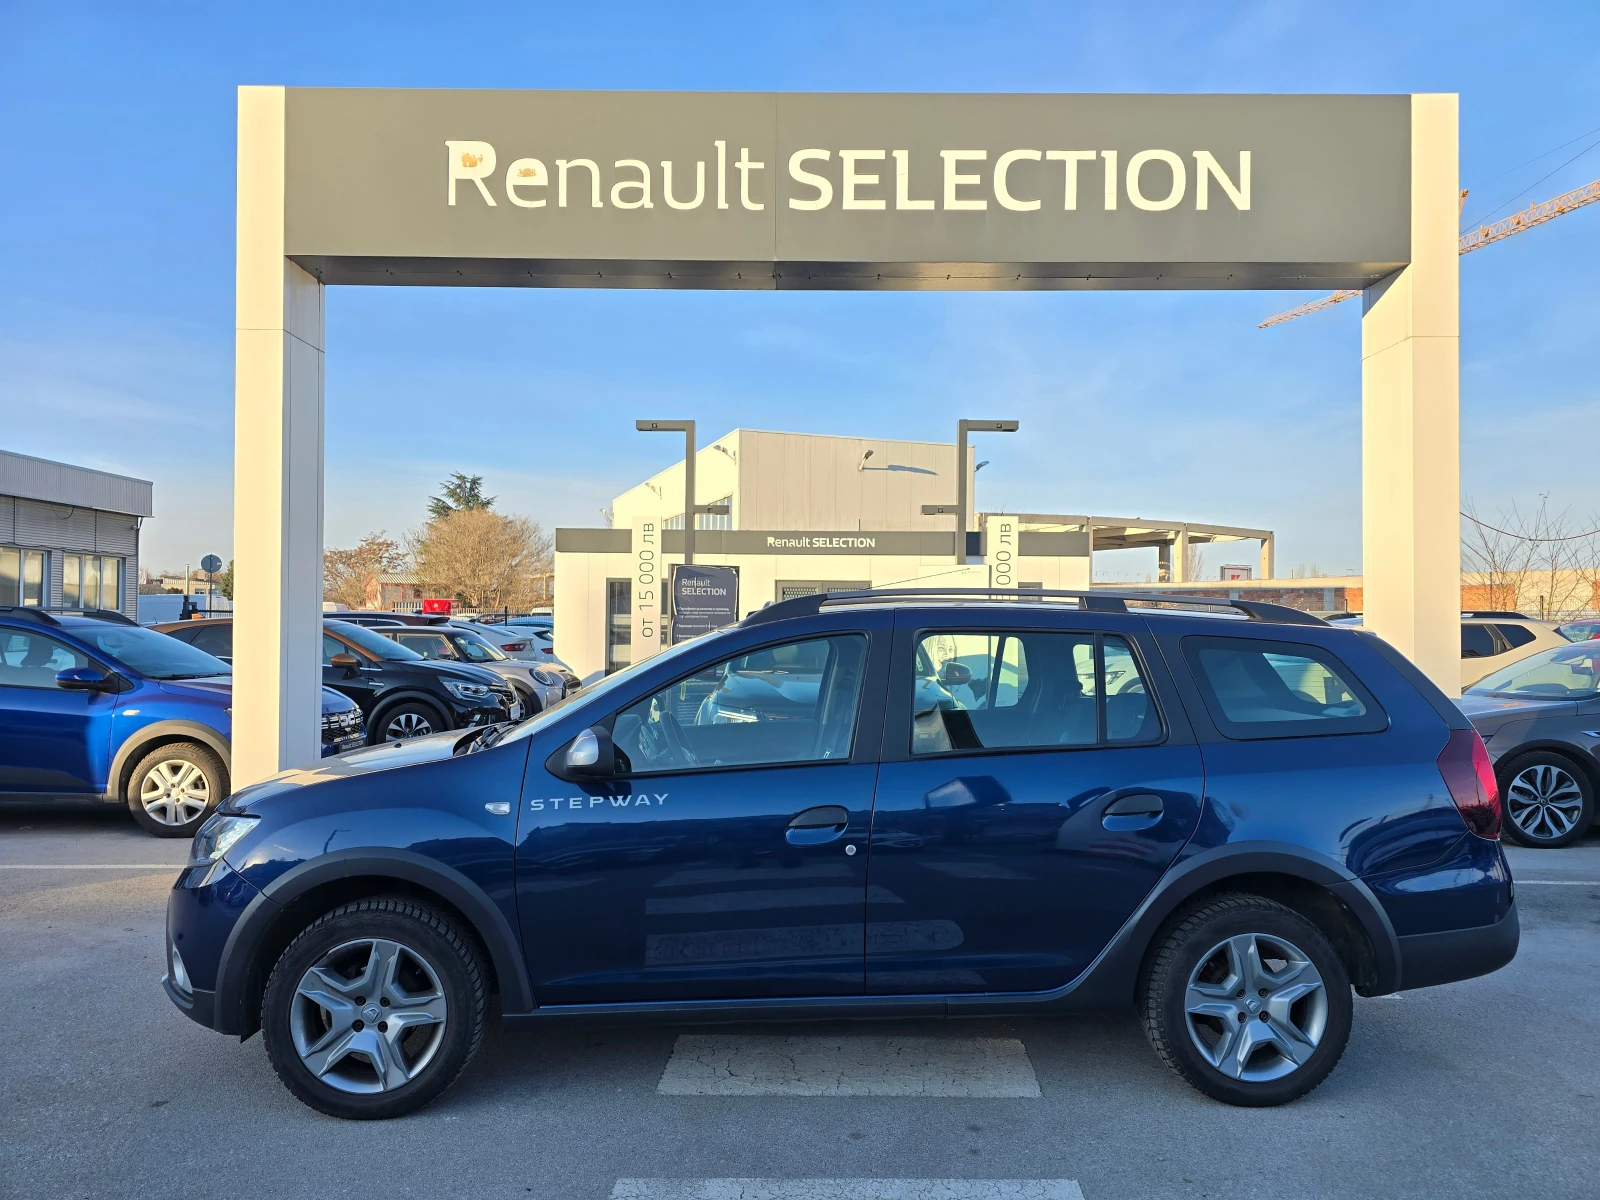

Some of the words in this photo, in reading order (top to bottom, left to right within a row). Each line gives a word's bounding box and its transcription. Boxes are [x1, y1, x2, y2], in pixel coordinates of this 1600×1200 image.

[445, 140, 765, 211] Renault
[788, 149, 1252, 212] SELECTION
[767, 536, 811, 548] Renault
[812, 537, 876, 548] SELECTION
[639, 550, 654, 584] 000
[995, 550, 1012, 586] 000
[681, 577, 711, 588] Renault
[681, 587, 727, 596] SELECTION
[639, 590, 654, 611] 15
[134, 756, 157, 781] UNIROYAL
[530, 793, 669, 811] STEPWAY
